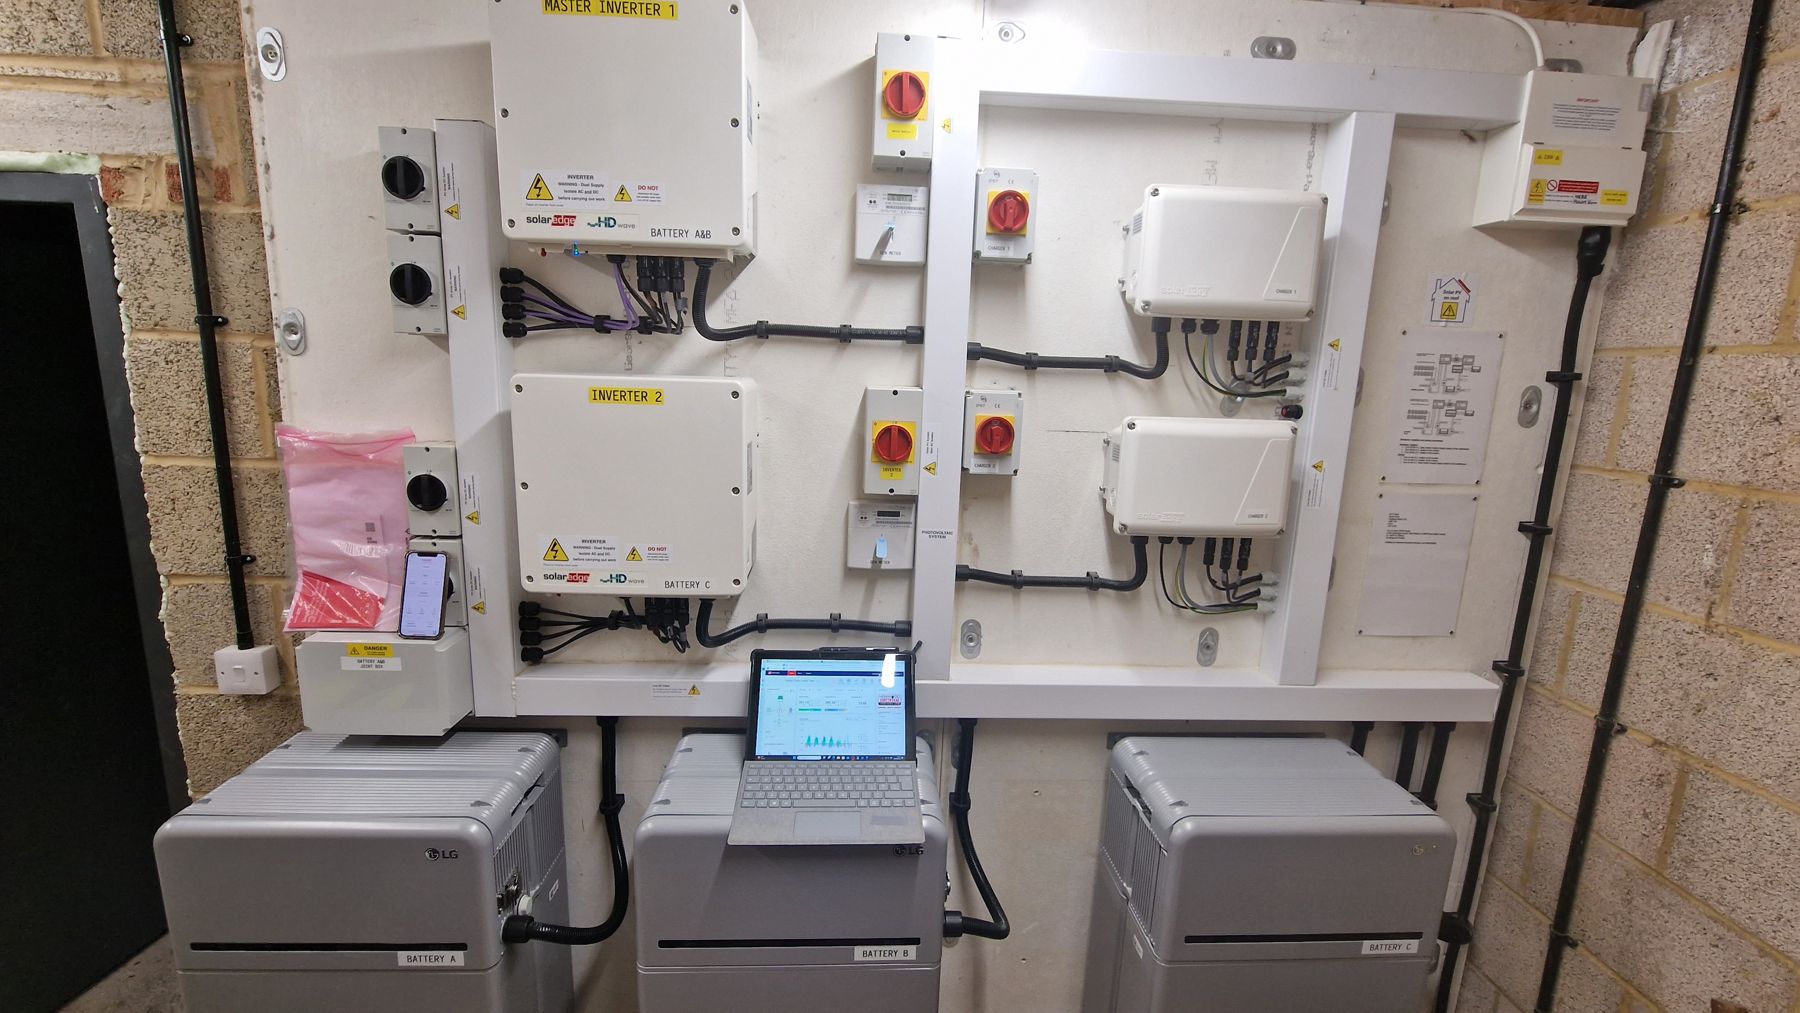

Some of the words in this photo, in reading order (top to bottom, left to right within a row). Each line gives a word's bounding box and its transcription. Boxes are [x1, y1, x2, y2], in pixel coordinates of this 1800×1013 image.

[544, 0, 592, 12] MASTER
[600, 0, 661, 16] INVERTER
[669, 4, 674, 17] 1
[598, 216, 617, 228] HD
[650, 228, 689, 238] BATTERY
[695, 230, 712, 239] A&B
[592, 390, 648, 402] INVERTER
[655, 391, 662, 402] 2
[610, 574, 627, 584] HD
[664, 580, 700, 589] BATTERY
[705, 581, 711, 589] C
[442, 850, 458, 859] LG
[909, 846, 924, 855] LG
[407, 955, 445, 963] BATTERY
